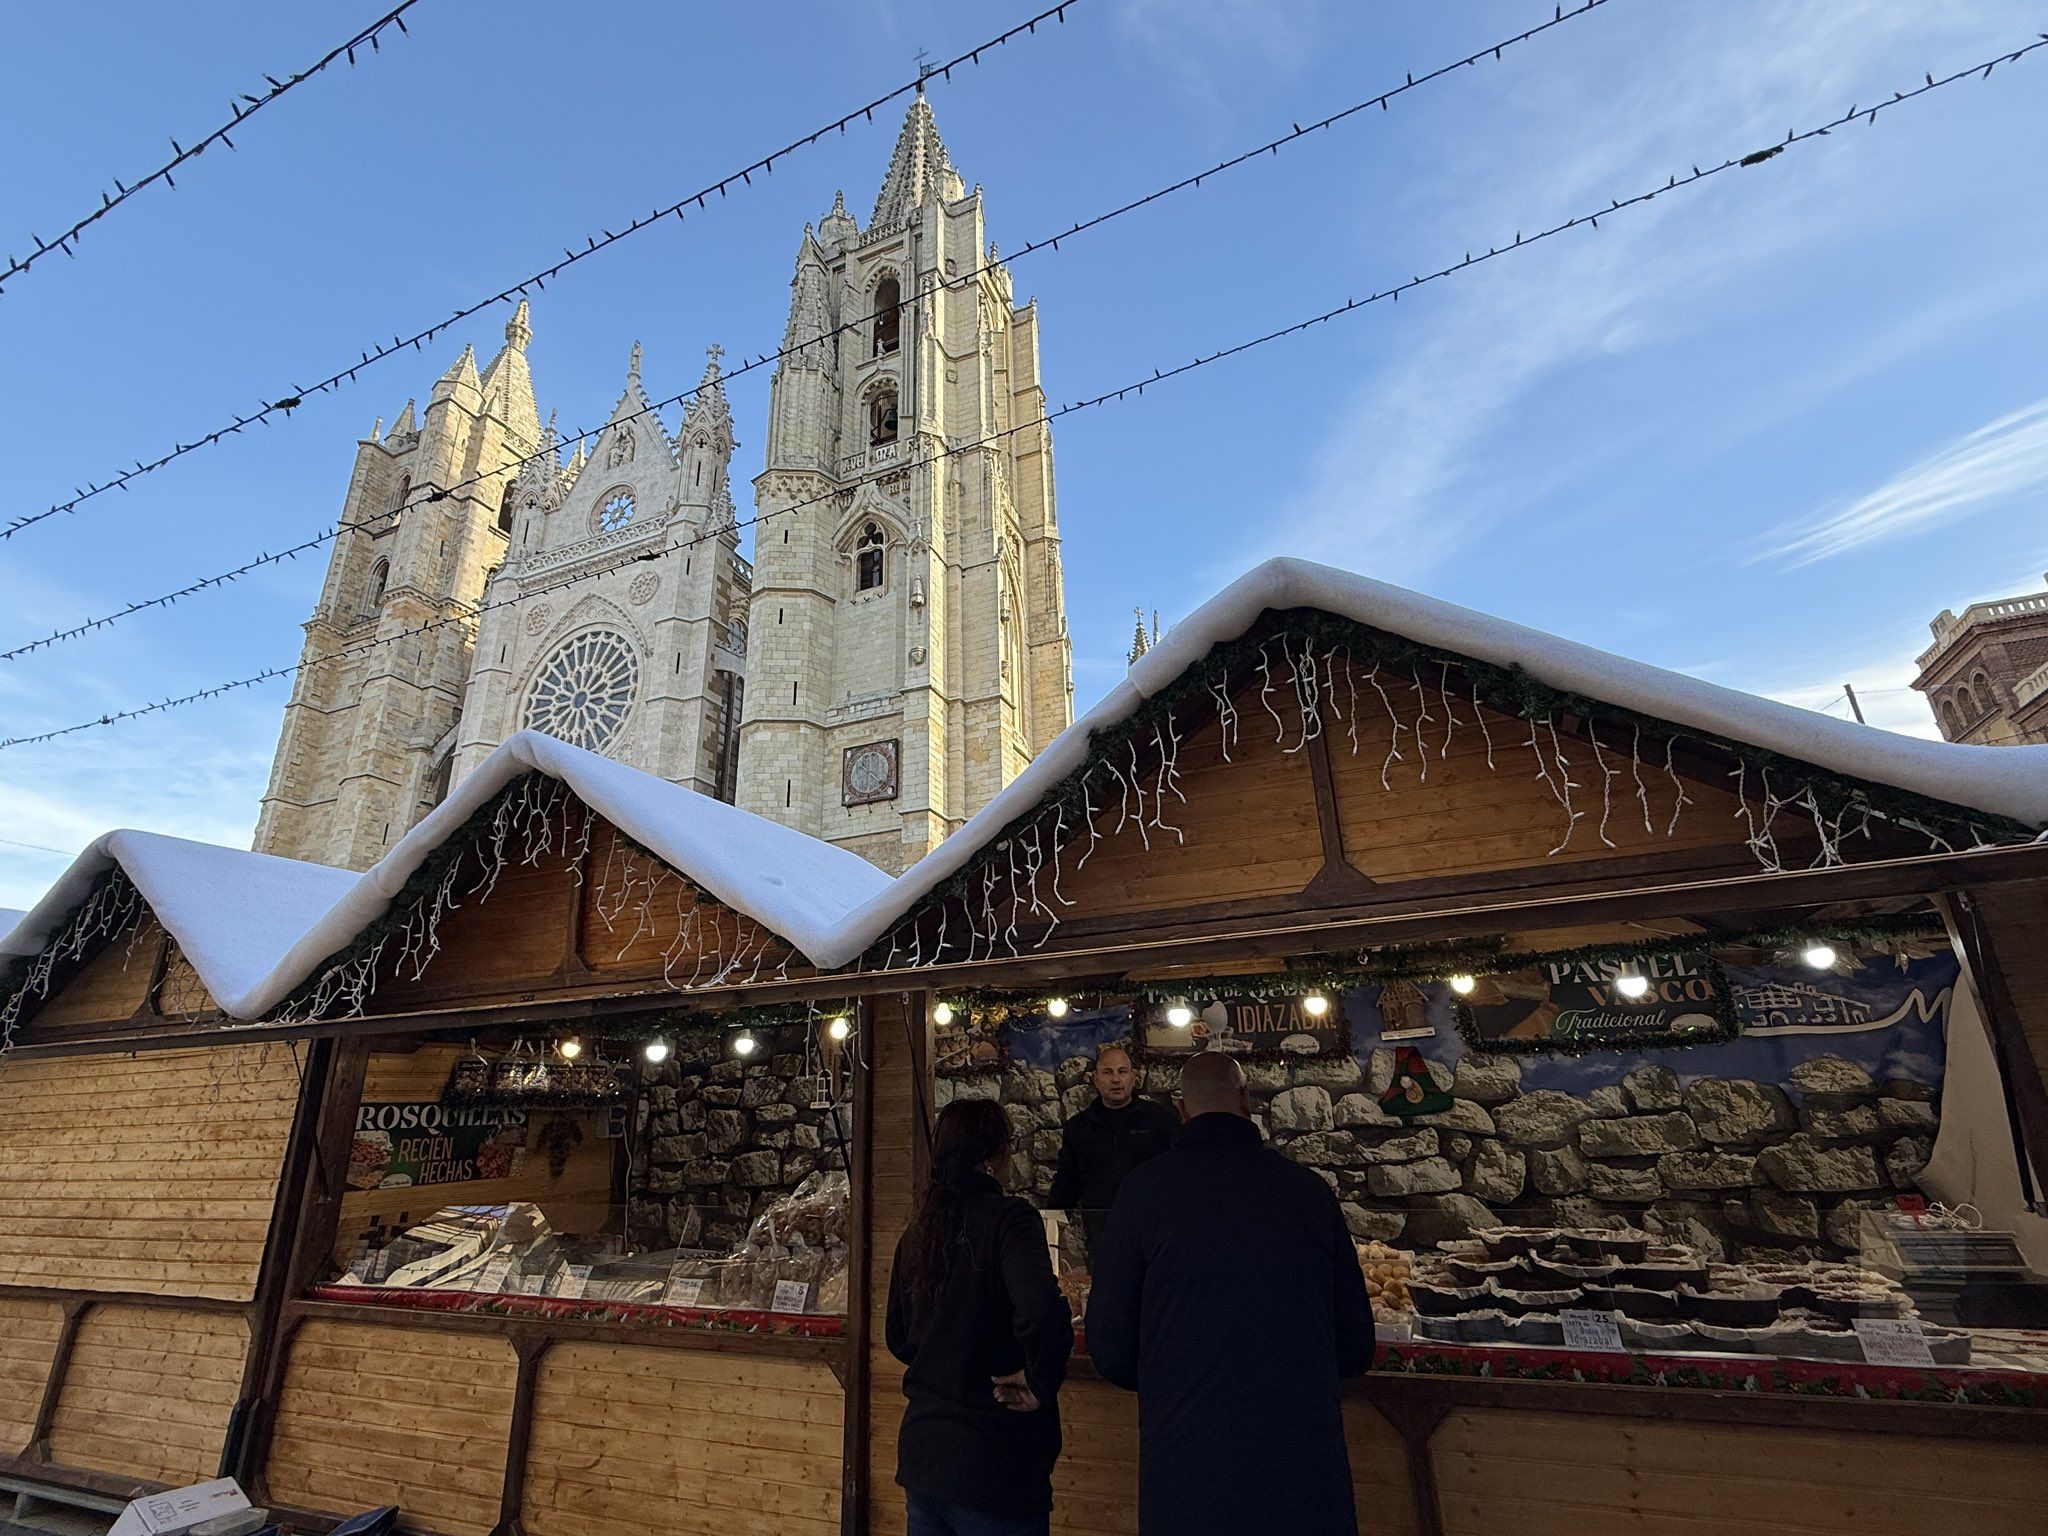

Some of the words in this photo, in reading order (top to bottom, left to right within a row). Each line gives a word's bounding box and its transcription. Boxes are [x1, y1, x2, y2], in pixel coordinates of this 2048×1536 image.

[1555, 1008, 1667, 1035] Tradicional
[355, 1104, 526, 1135] ROSQUILLAS
[397, 1134, 454, 1162] RECIÉN
[418, 1159, 474, 1184] HECHAS
[1595, 1314, 1609, 1324] 25
[1895, 1323, 1913, 1334] 25
